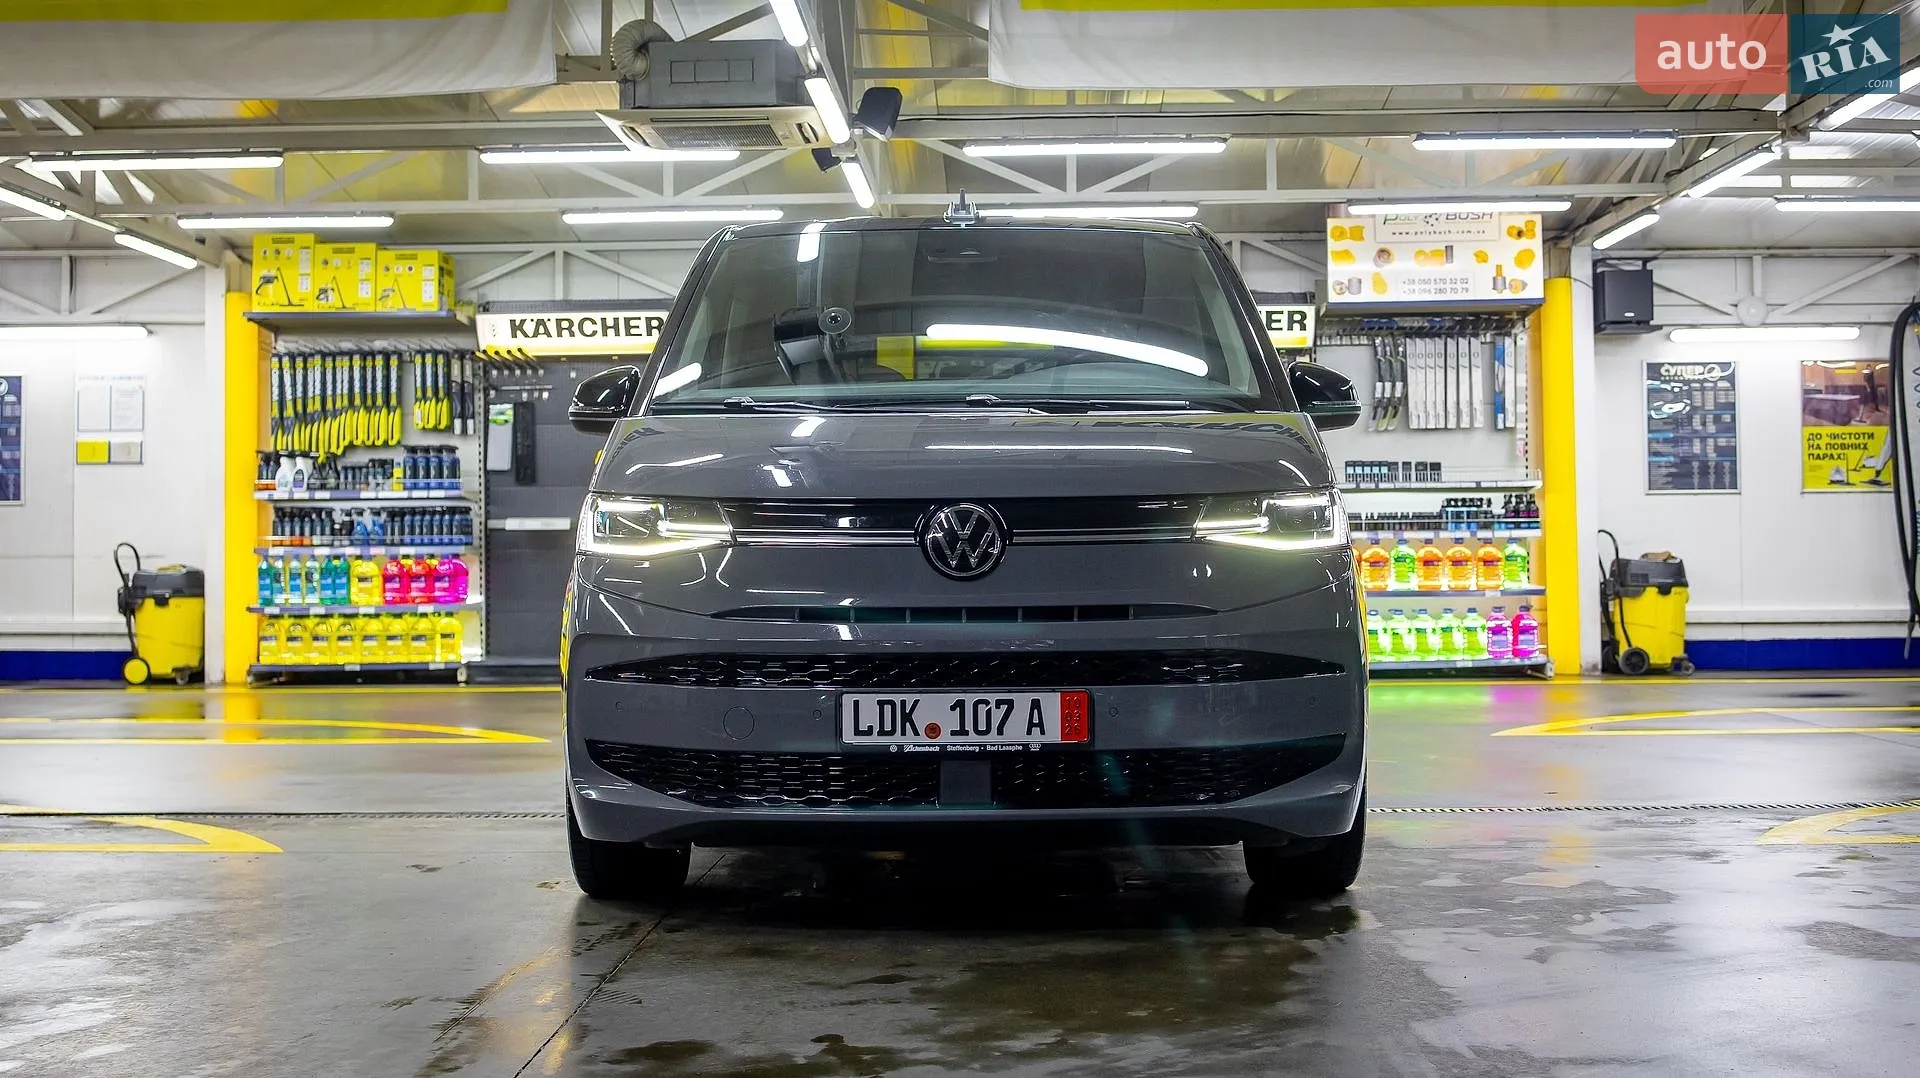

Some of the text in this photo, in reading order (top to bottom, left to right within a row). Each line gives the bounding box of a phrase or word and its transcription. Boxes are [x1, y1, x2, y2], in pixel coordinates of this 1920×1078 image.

[509, 317, 664, 338] KÄRCHER
[1807, 432, 1874, 441] ДО ЧИСТОТИ
[1826, 442, 1868, 450] ПОВНИХ
[1808, 452, 1846, 460] ПАРАХ!
[852, 698, 1046, 737] LDK 107 A
